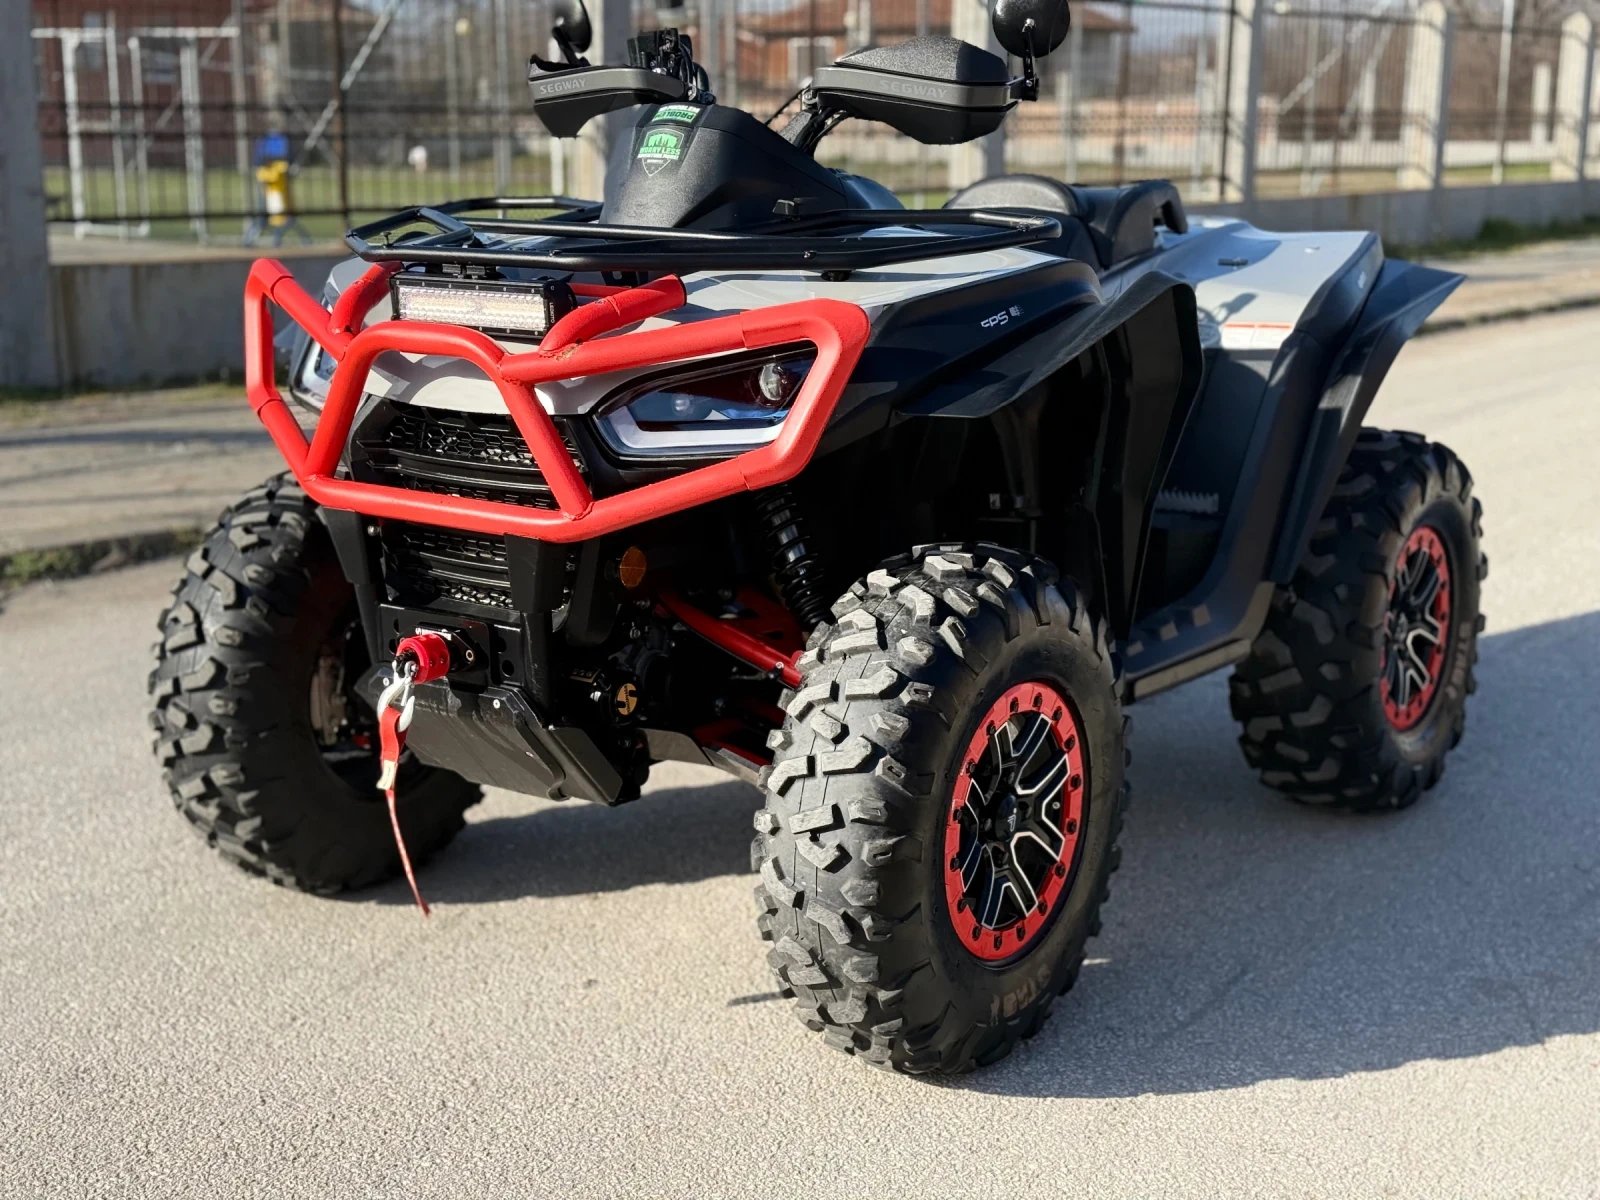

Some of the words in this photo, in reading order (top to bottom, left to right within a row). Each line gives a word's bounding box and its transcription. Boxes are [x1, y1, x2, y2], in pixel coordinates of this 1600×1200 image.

[540, 78, 586, 95] SEGWAY
[880, 80, 948, 99] SEGWAY
[661, 147, 681, 156] LESS
